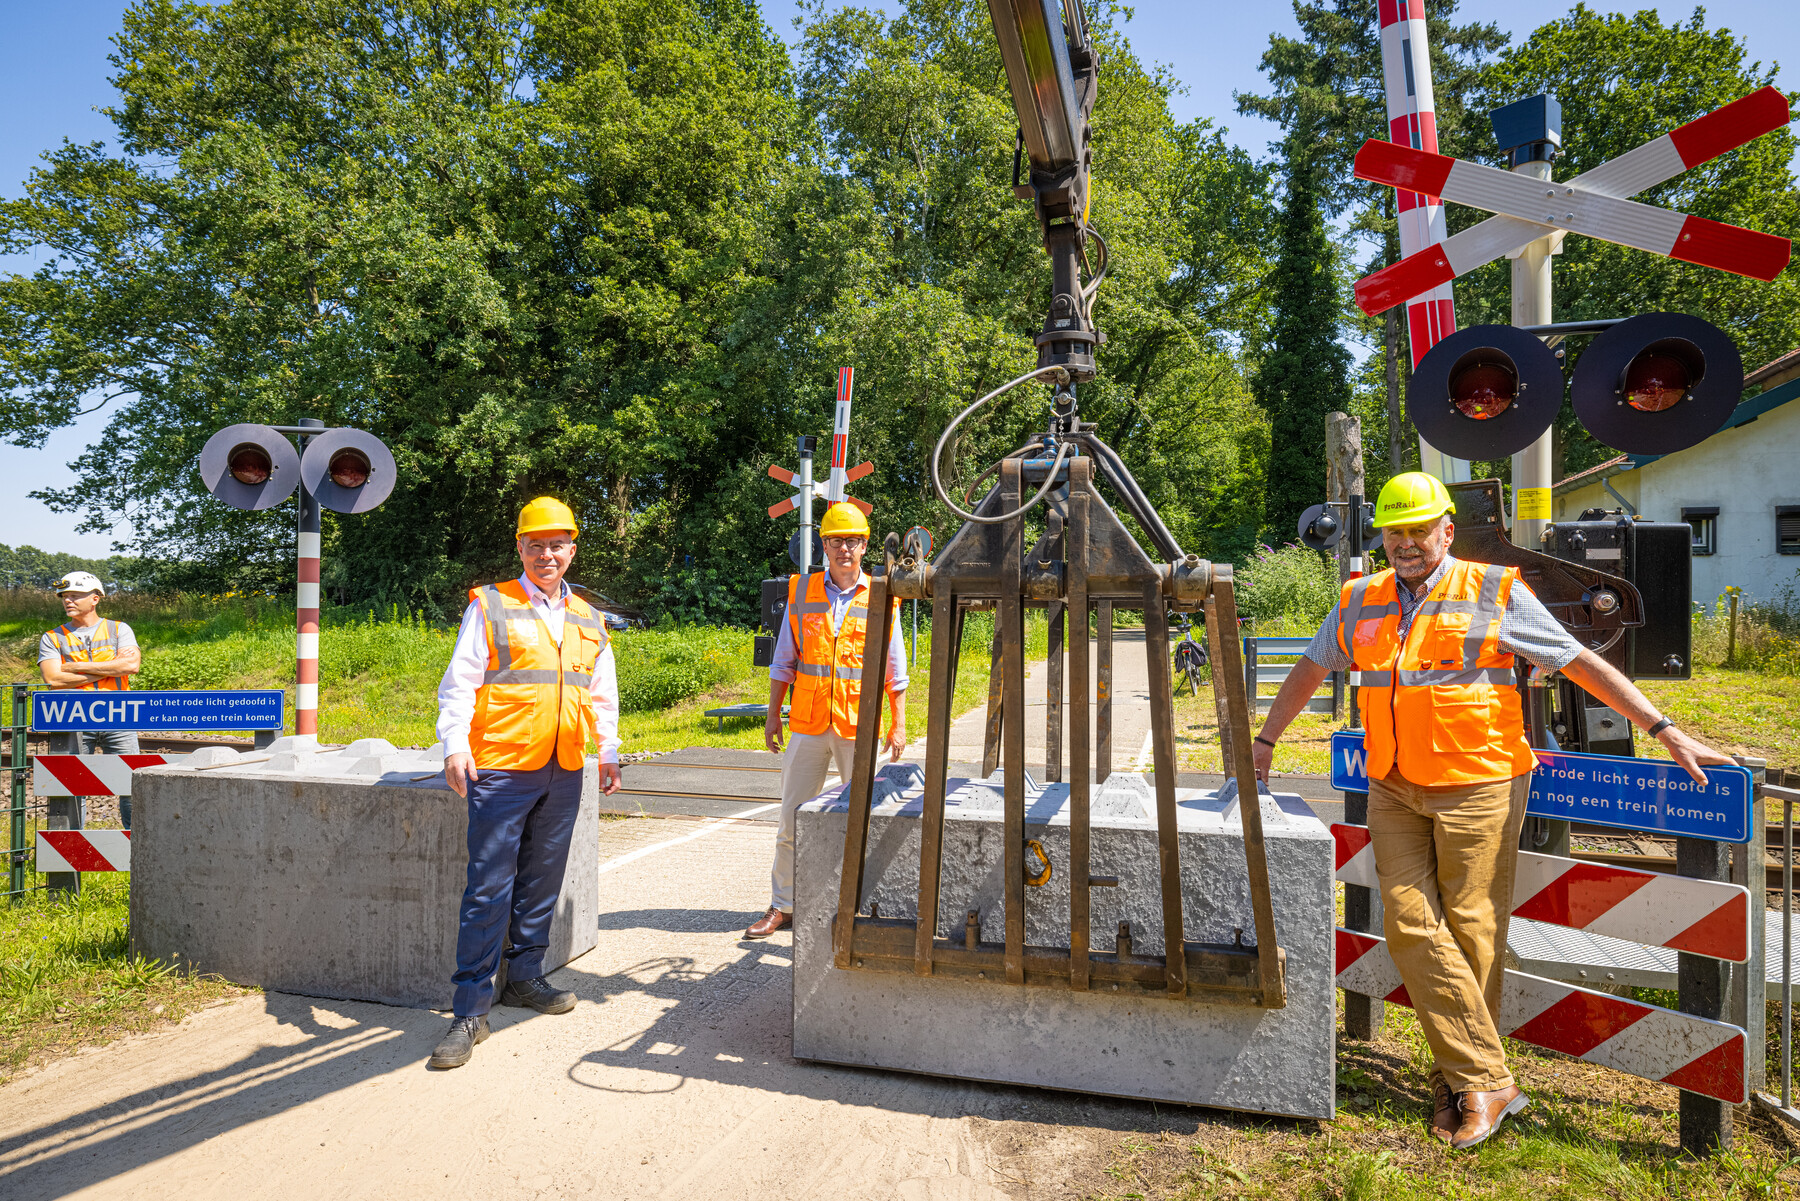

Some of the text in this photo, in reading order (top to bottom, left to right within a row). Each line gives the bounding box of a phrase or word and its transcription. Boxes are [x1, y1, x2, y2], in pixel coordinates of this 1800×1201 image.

[1384, 501, 1415, 511] ProRail
[149, 697, 276, 708] tot het rode licht gedoofd is
[41, 701, 146, 723] WACHT
[162, 714, 178, 722] kan
[181, 715, 198, 724] nog
[220, 713, 242, 721] trein
[245, 713, 276, 721] komen
[1531, 765, 1545, 776] et
[1551, 768, 1585, 780] rode
[1592, 770, 1629, 785] licht
[1715, 783, 1730, 796] is
[1547, 792, 1574, 807] nog
[1581, 796, 1609, 813] een
[1616, 799, 1658, 814] trein
[1666, 803, 1726, 822] komen
